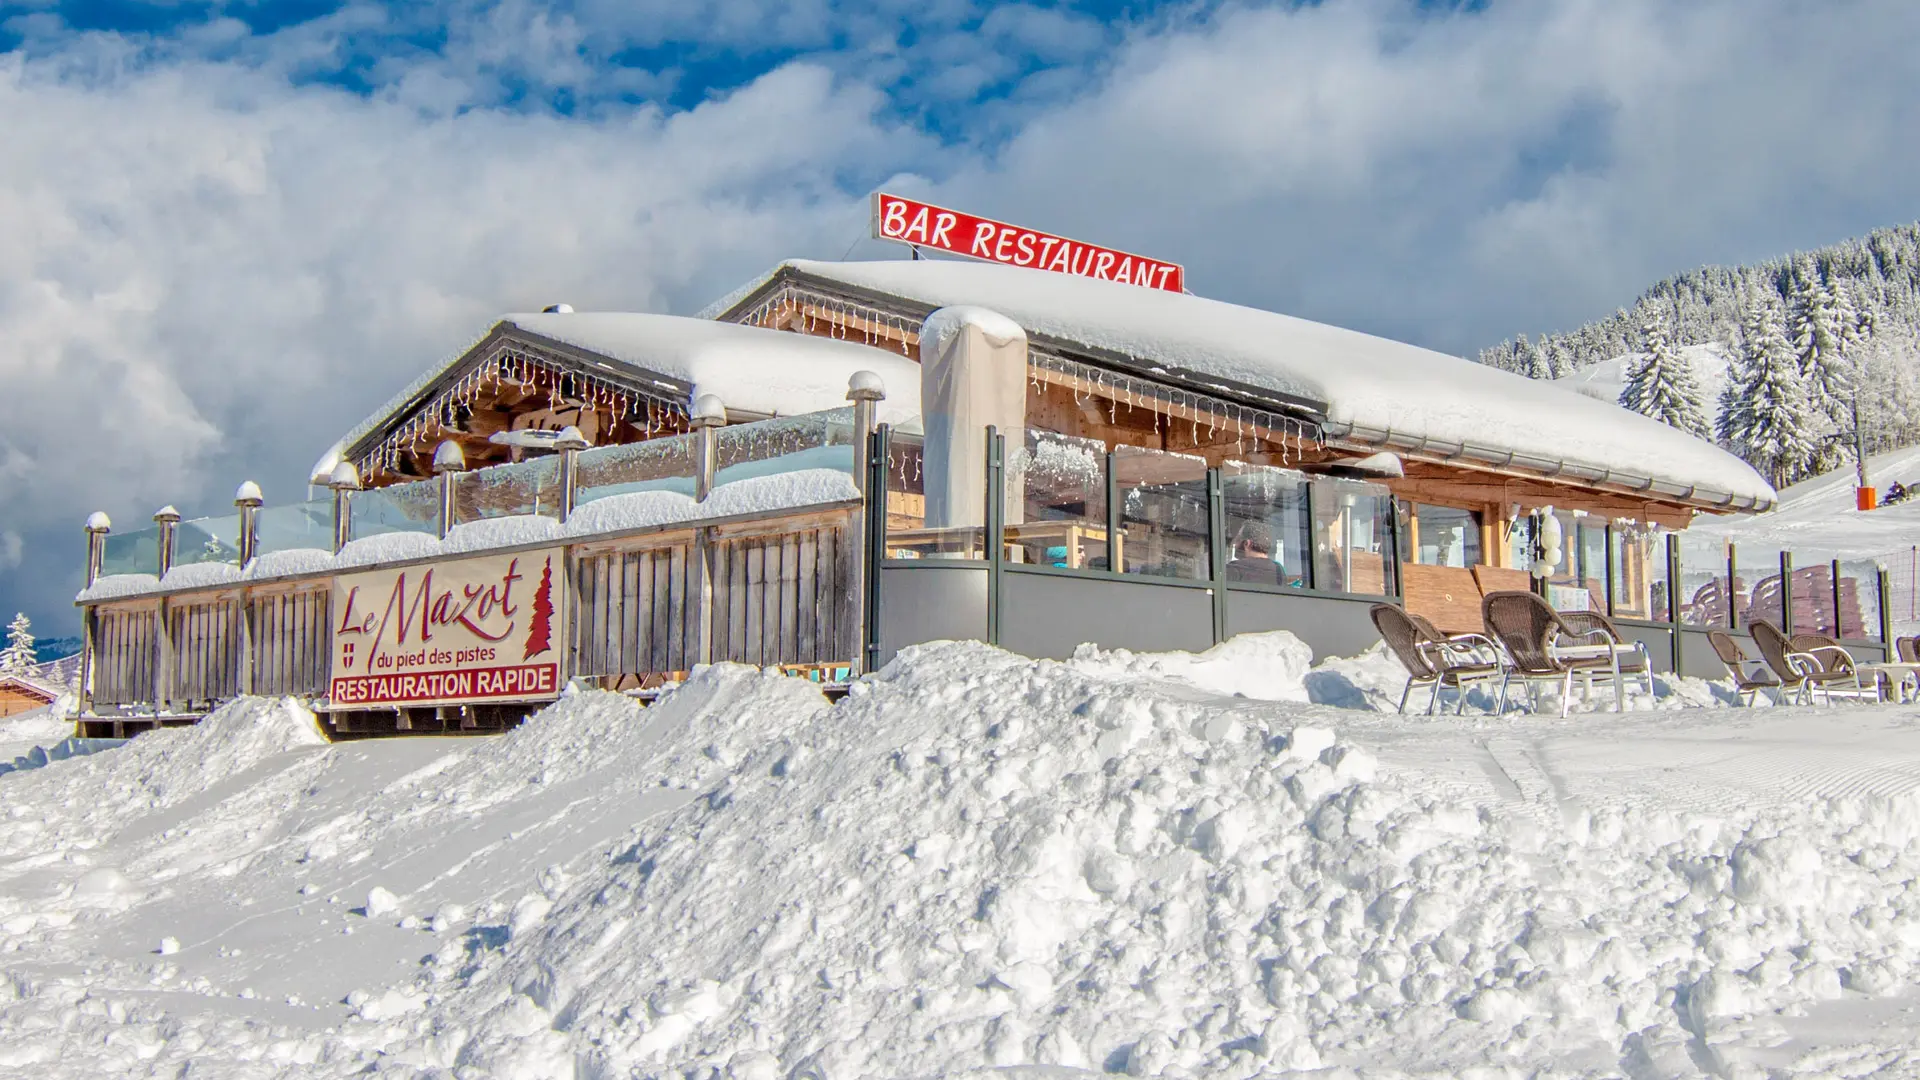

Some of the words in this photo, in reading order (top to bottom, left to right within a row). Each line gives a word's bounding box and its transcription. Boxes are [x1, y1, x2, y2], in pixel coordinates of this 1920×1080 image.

[883, 201, 957, 248] BAR
[971, 222, 1176, 290] RESTAURANT
[338, 586, 379, 635] Le
[367, 557, 523, 673] Mazot
[335, 673, 472, 702] RESTAURATION
[477, 667, 552, 694] RAPIDE
[377, 651, 393, 668] du
[396, 648, 425, 672] pied
[428, 648, 452, 667] des
[455, 645, 496, 668] pistes
